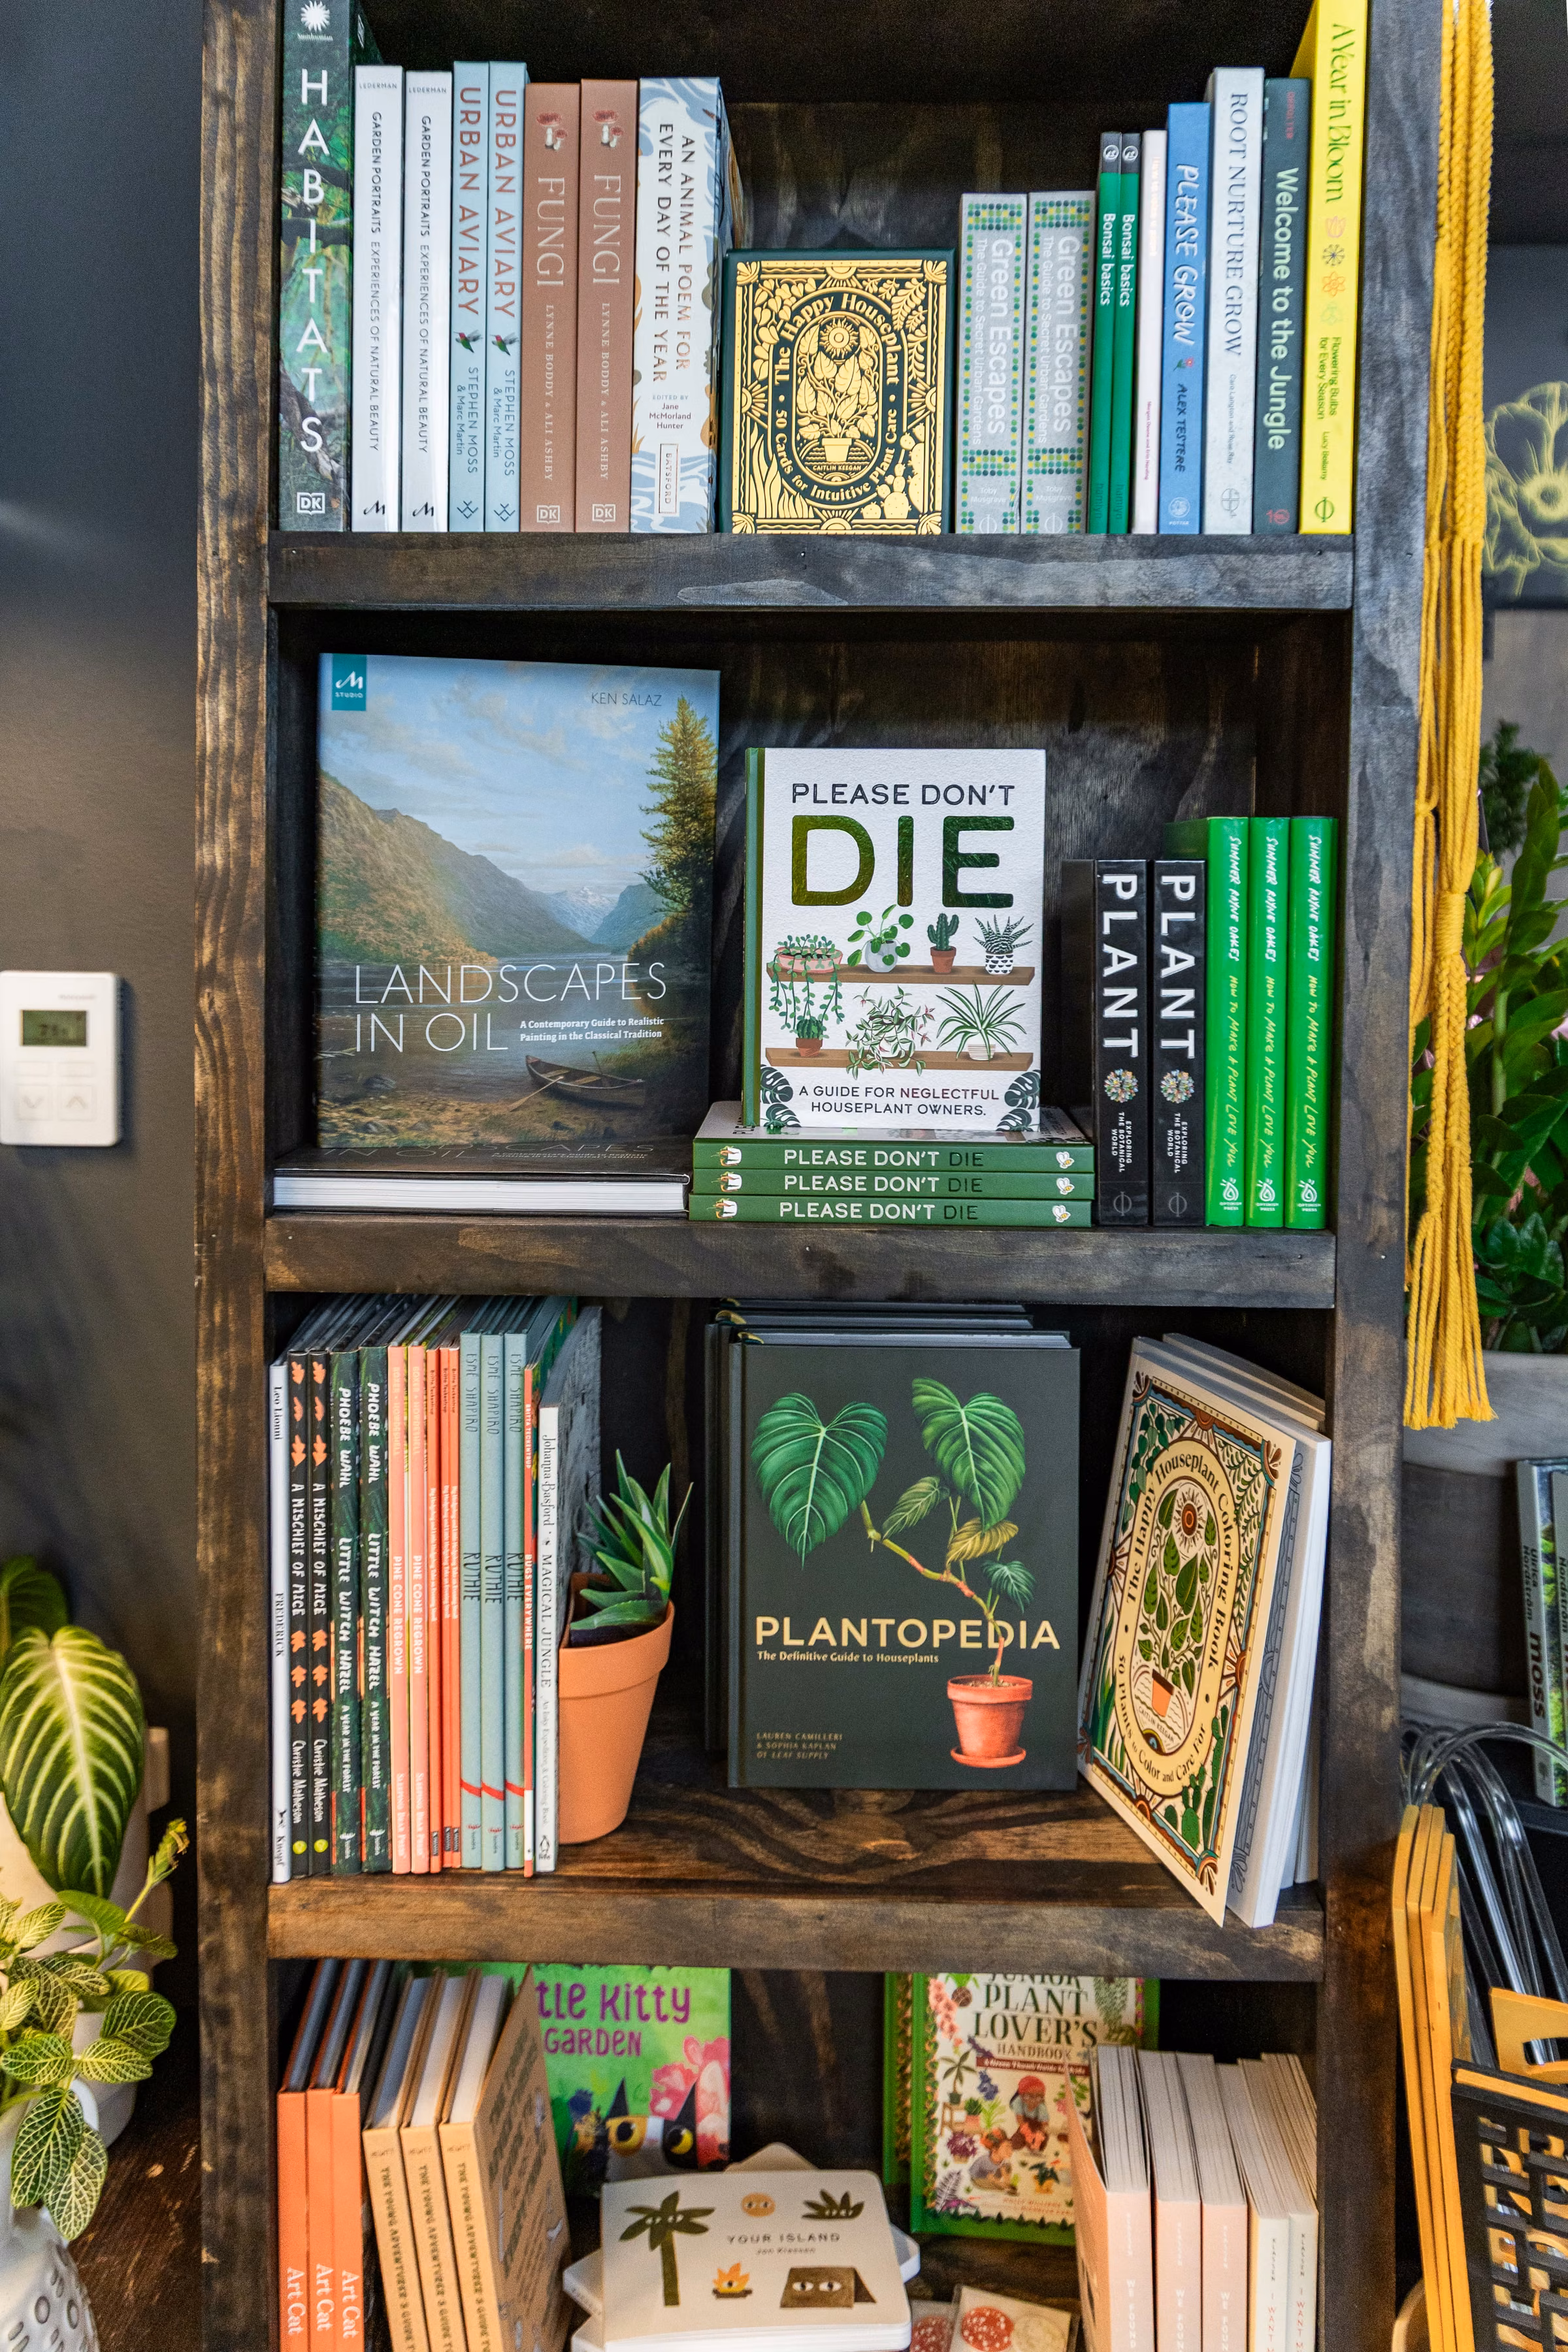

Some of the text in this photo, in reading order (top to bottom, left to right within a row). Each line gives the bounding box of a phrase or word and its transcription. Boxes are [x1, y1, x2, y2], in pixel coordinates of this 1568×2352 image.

[1325, 23, 1356, 204] A Year in Bloom
[458, 88, 481, 315] URBAN AVIARY
[537, 177, 564, 286] FUNGI
[1225, 93, 1248, 355] ROOT NURTURE GROW
[1273, 167, 1299, 281] Welcome
[296, 68, 331, 452] HABITATS
[369, 111, 382, 451] GARDEN PORTRAITS EXPERIENCES OF NATURAL BEAUTY
[653, 123, 673, 382] EVERY DAY OF THE YEAR
[677, 136, 696, 369] AN ANIMAL POEM FOR
[1100, 214, 1116, 306] Bonsai basics
[1173, 164, 1200, 346] PLEASE GROW
[775, 293, 902, 385] The Happy Houseplant
[983, 238, 1013, 434] Green Escapes
[1271, 318, 1295, 359] the
[1272, 286, 1294, 312] to
[467, 367, 478, 473] STEPHEN MOSS
[1263, 366, 1292, 450] Jungle
[591, 692, 662, 706] KEN SALAZ
[792, 783, 1015, 806] PLEASE DON'T
[791, 815, 1015, 908] DIE
[1228, 836, 1242, 962] SUMMER RAYNE OAKES
[356, 962, 666, 1004] LANDSCAPES
[1102, 874, 1139, 1058] PLANT
[356, 1013, 509, 1053] IN OIL
[520, 1017, 664, 1030] A Contemporary Guide to Realistic
[520, 1029, 662, 1043] Painting in the Classical Tradition
[799, 1085, 999, 1100] A GUIDE FOR NEGLECTFUL
[811, 1102, 987, 1117] HOUSEPLANT OWNERS.
[785, 1150, 985, 1168] PLEASE DON'T DIE
[463, 1353, 480, 1601] ESME SHAPIRO RUTHIE
[338, 1387, 353, 1694] PHOEBE WAHL LITTLE WITCH HAZEL
[540, 1434, 555, 1688] Johanna Basford MAGICAL JUNGLE
[1126, 1452, 1233, 1671] The Happy Houseplant Coloring Book
[1524, 1545, 1533, 1620] Nordström
[275, 1593, 284, 1658] FREDERICK
[291, 1484, 307, 1823] A MISCHIEF OF MICE Christie Matheson
[392, 1556, 402, 1674] PINE CONE REGROWN
[756, 1616, 1060, 1650] PLANTOPEDIA
[757, 1651, 939, 1665] The Definitive Guide to Houseplants
[1530, 1632, 1545, 1719] moss
[796, 1752, 829, 1760] SUPPLY
[802, 1742, 837, 1751] KAPLAN
[1118, 1652, 1207, 1783] 50 Plants to Color and Care For
[274, 1837, 284, 1867] Knopf
[973, 2011, 1098, 2048] LOVER'S
[984, 1984, 1088, 2016] PLANT
[997, 2042, 1071, 2060] HANDBOOK
[727, 2232, 840, 2244] YOUR ISLAND
[287, 2267, 306, 2336] Art Cat
[1126, 2280, 1135, 2296] WE
